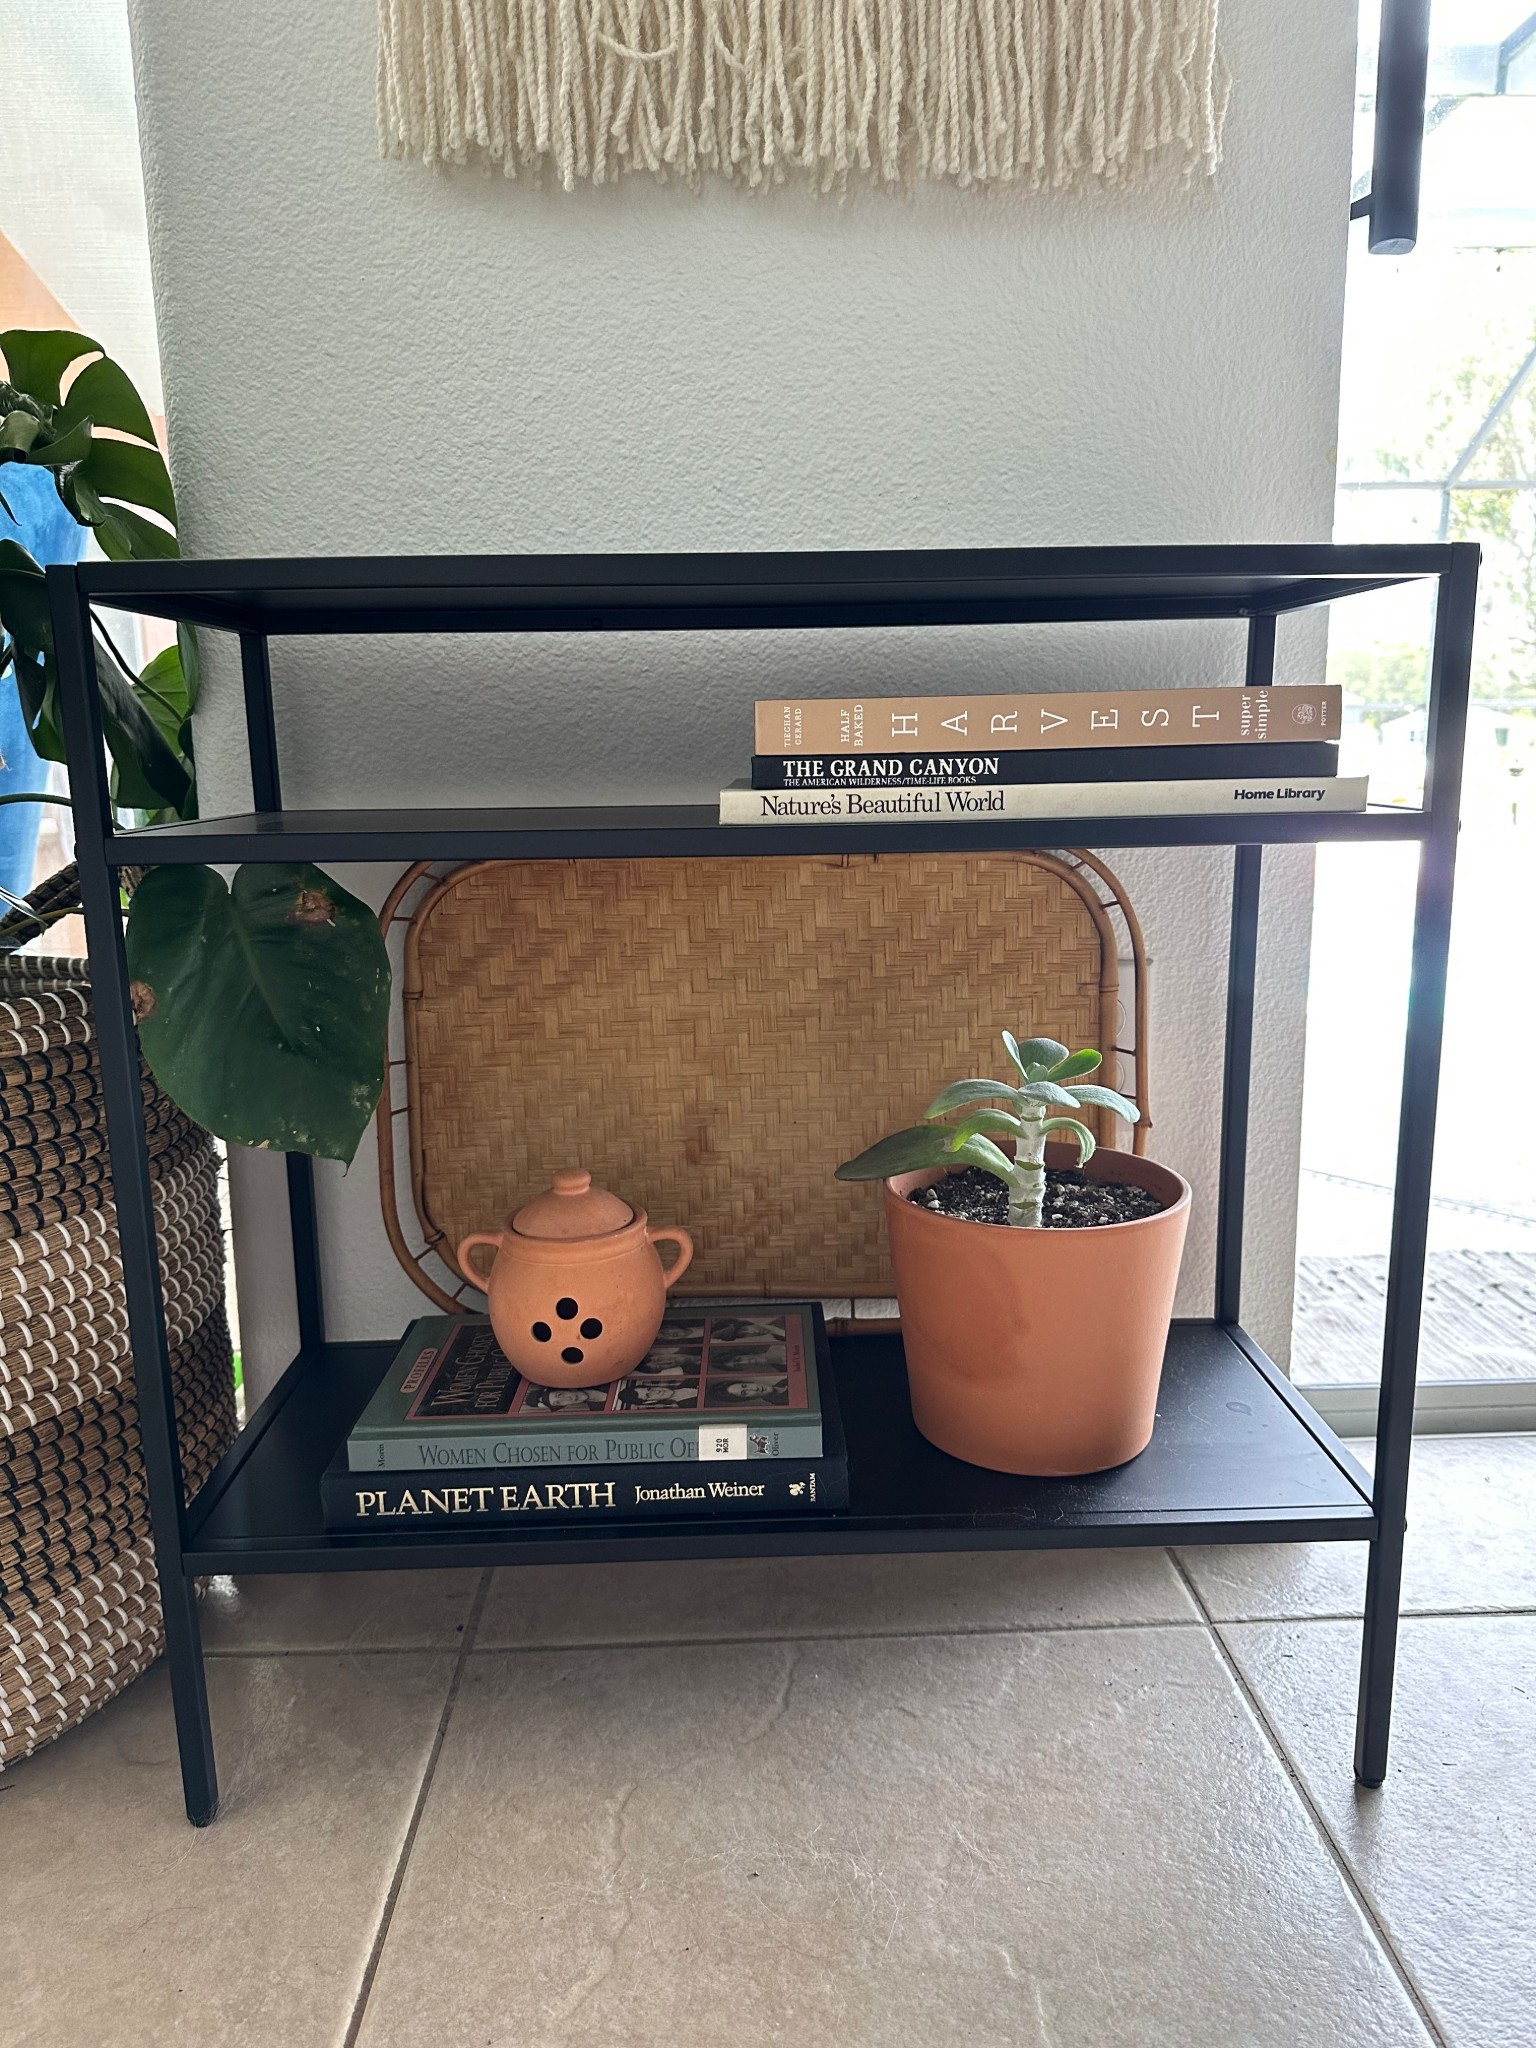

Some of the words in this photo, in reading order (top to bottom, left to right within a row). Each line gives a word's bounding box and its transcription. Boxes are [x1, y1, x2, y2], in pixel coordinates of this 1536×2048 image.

[783, 706, 791, 748] TIEGHAN
[840, 709, 850, 743] HALF
[853, 704, 864, 747] BAKED
[1240, 694, 1253, 736] super
[1254, 690, 1271, 739] simple
[1320, 701, 1328, 726] POTTER
[782, 760, 825, 778] THE
[830, 759, 903, 778] GRAND
[909, 757, 1000, 776] CANYON
[783, 778, 800, 788] THE
[801, 778, 847, 787] AMERICAN
[947, 775, 978, 785] BOOKS
[760, 793, 842, 817] Nature's
[845, 791, 942, 815] Beautiful
[945, 790, 1006, 813] World
[1233, 788, 1275, 800] Home
[1276, 787, 1326, 802] Library
[403, 1350, 436, 1390] PROFILES
[772, 1432, 780, 1457] Oliver
[355, 1486, 495, 1517] PLANET
[499, 1481, 617, 1511] EARTH
[634, 1483, 707, 1505] Jonathan
[707, 1480, 766, 1499] Weiner
